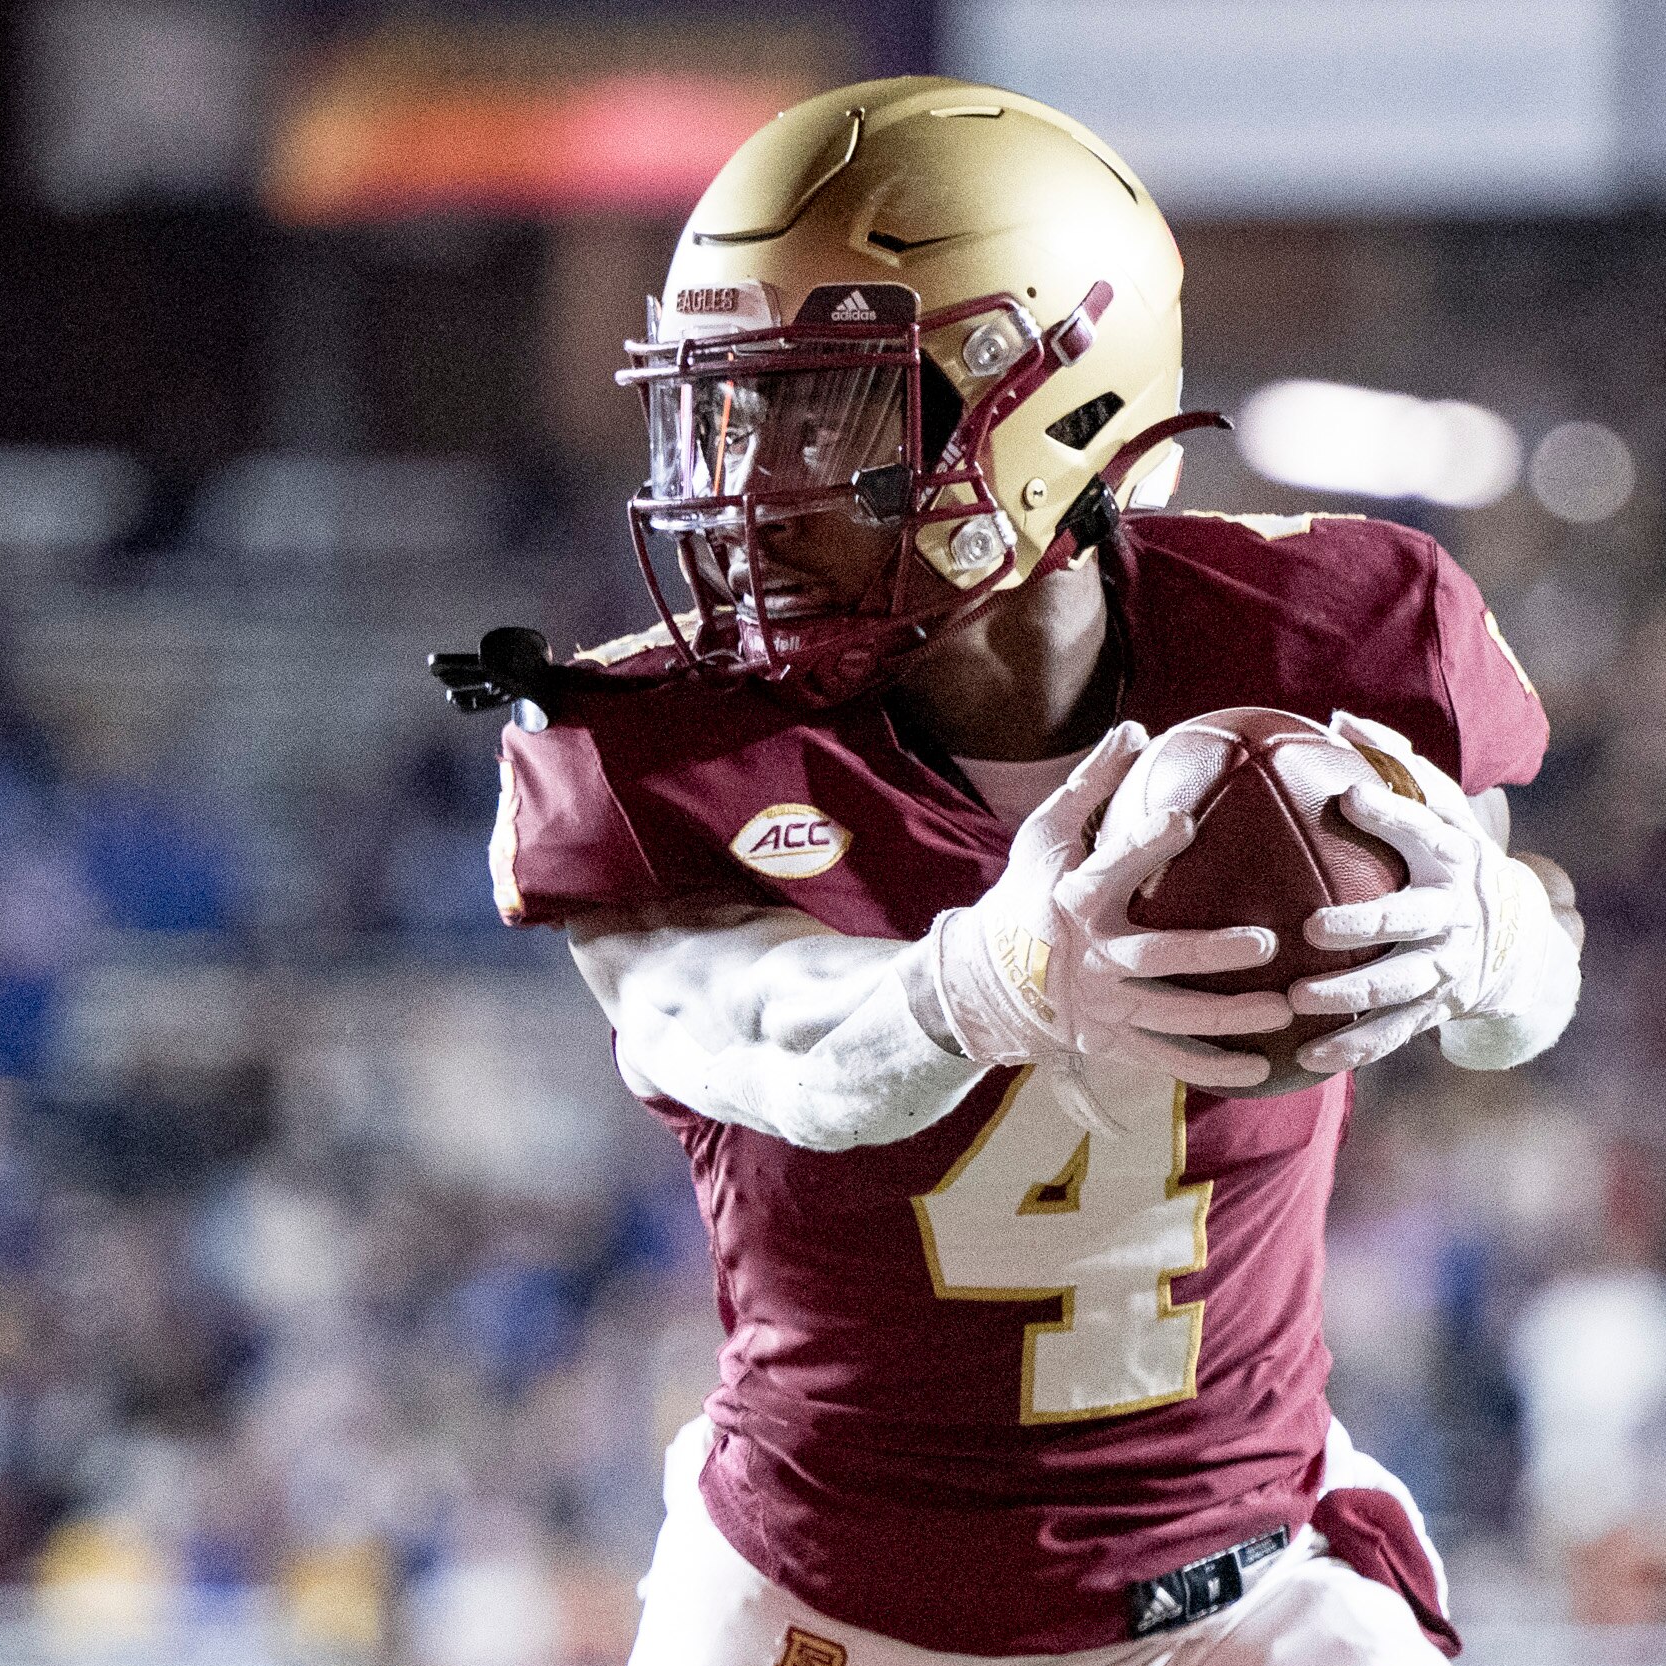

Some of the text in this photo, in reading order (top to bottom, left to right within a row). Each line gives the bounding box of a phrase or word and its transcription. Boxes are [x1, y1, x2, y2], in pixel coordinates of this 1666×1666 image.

[676, 287, 740, 315] EAGLES
[831, 309, 877, 322] adidas
[749, 820, 831, 853] ACC
[911, 1062, 1214, 1425] 4
